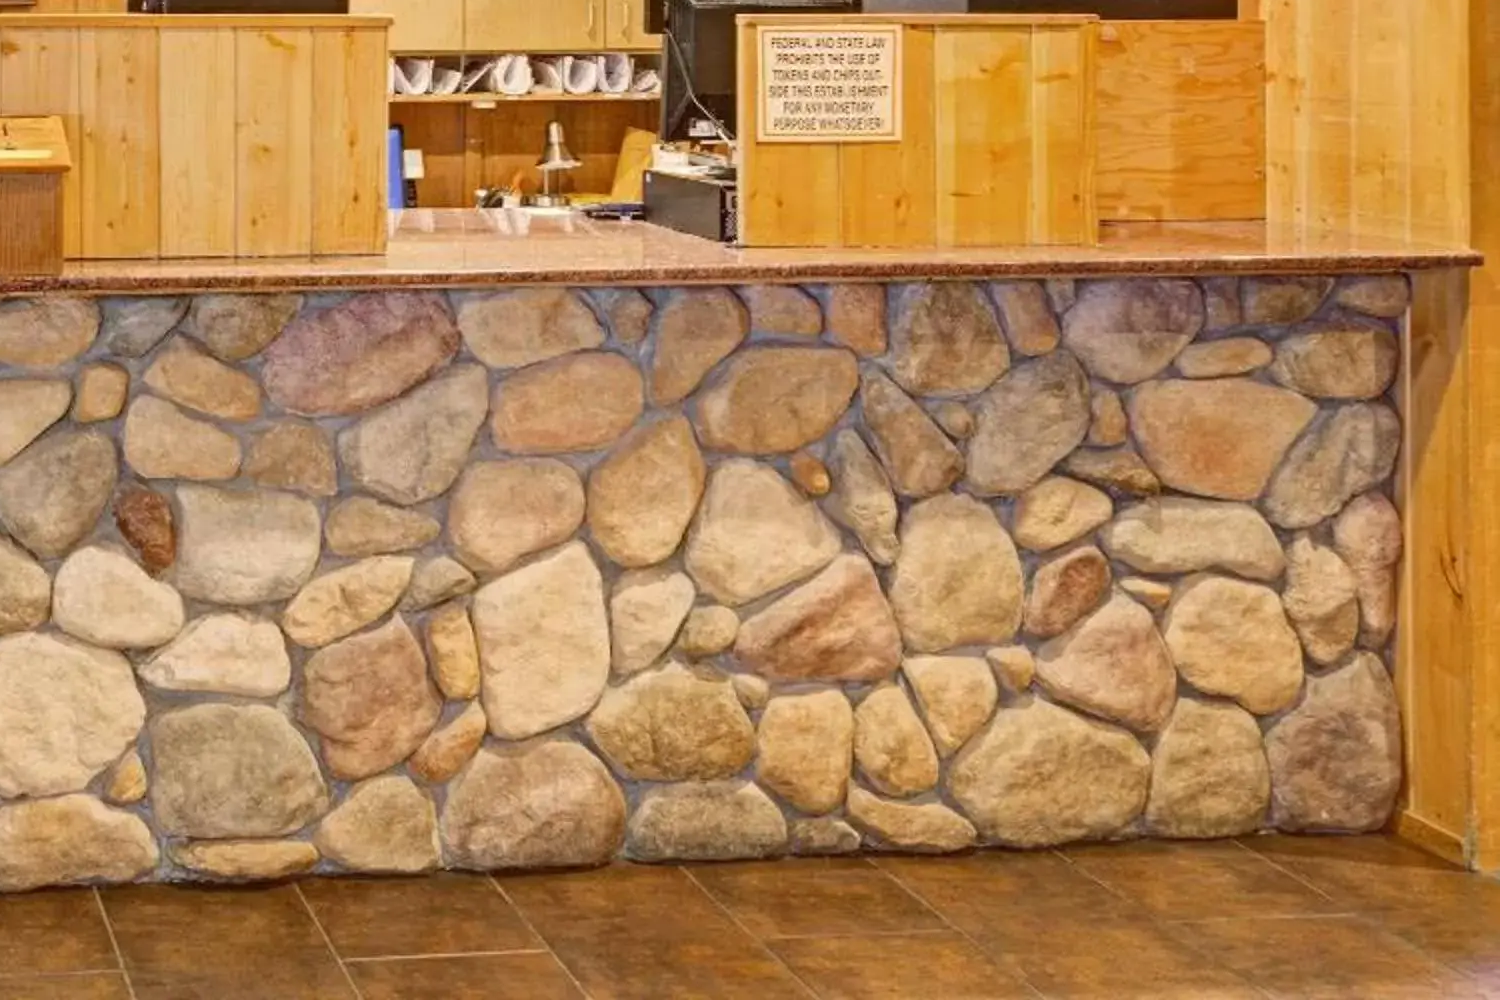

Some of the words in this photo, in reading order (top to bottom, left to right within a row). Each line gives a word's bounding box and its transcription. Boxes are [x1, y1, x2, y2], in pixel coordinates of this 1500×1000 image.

[771, 37, 812, 49] FEDERAL
[815, 37, 834, 49] AND
[836, 37, 865, 49] STATE
[866, 37, 886, 49] LAW
[776, 53, 825, 65] PROHIBITS
[827, 53, 845, 65] THE
[847, 53, 866, 65] USE
[867, 53, 881, 65] OF
[772, 69, 809, 81] TOKENS
[811, 69, 830, 81] AND
[833, 69, 860, 81] CHIPS
[768, 85, 789, 97] SIDE
[792, 85, 812, 97] THIS
[814, 85, 889, 97] ESTABLISHMENT
[783, 101, 803, 114] FOR
[805, 101, 823, 114] ANY
[825, 101, 875, 114] MONETARY
[773, 117, 816, 130] PURPOSE
